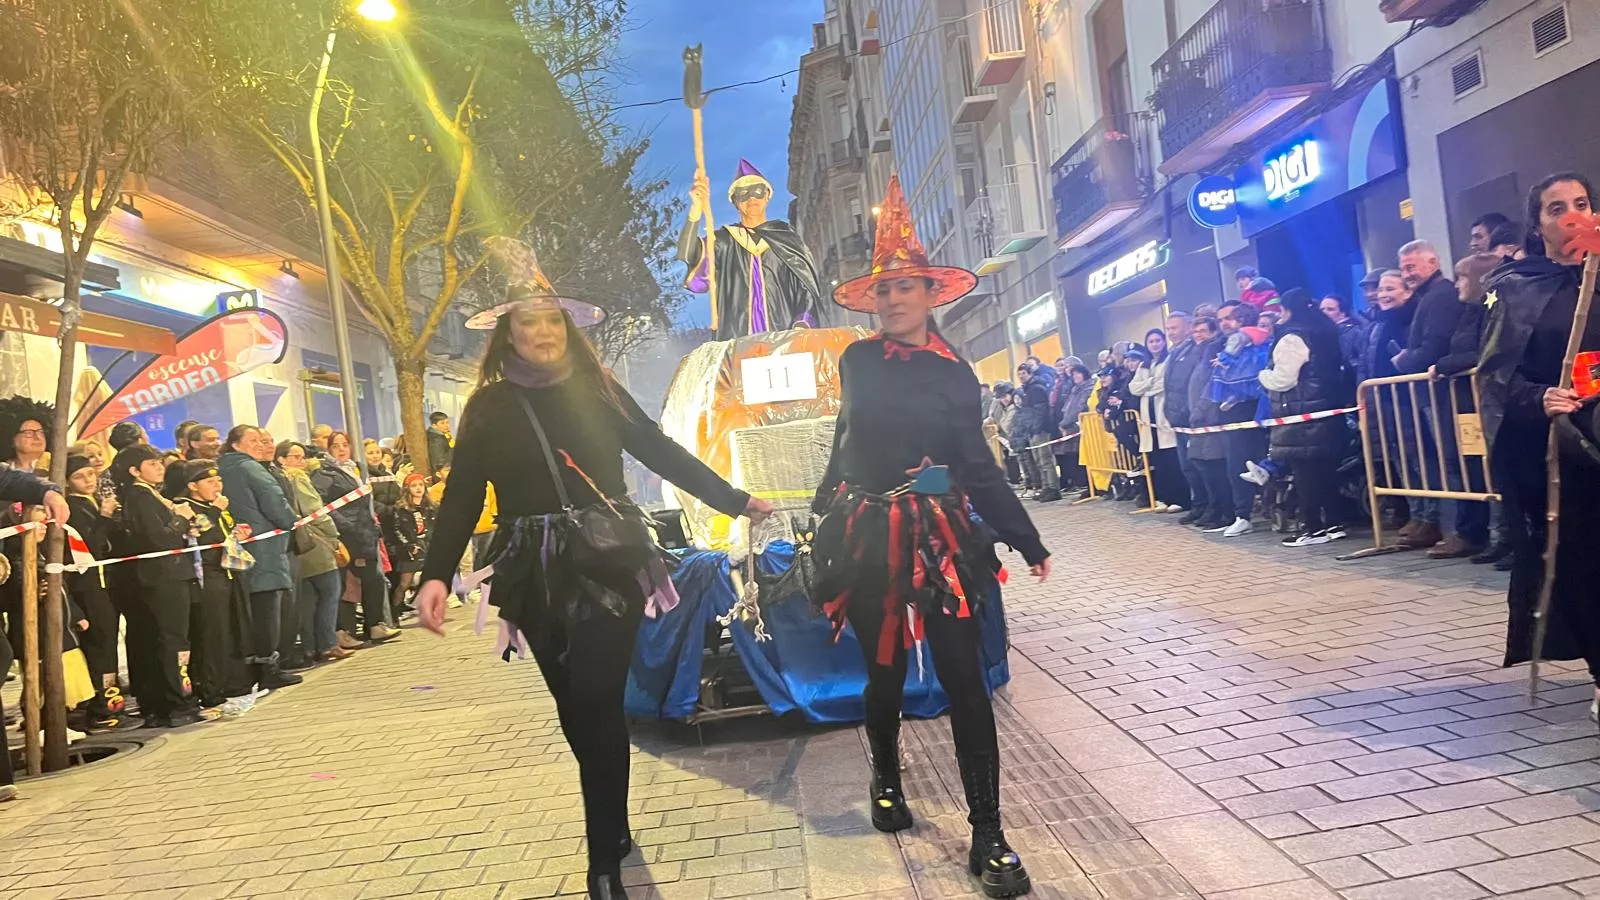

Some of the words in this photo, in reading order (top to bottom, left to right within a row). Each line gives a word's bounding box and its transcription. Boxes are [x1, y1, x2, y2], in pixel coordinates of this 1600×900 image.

[1263, 139, 1320, 201] DIGI
[1198, 189, 1235, 207] DIGI
[148, 347, 222, 381] oscense
[766, 366, 792, 389] 11
[118, 366, 222, 415] TARDEO
